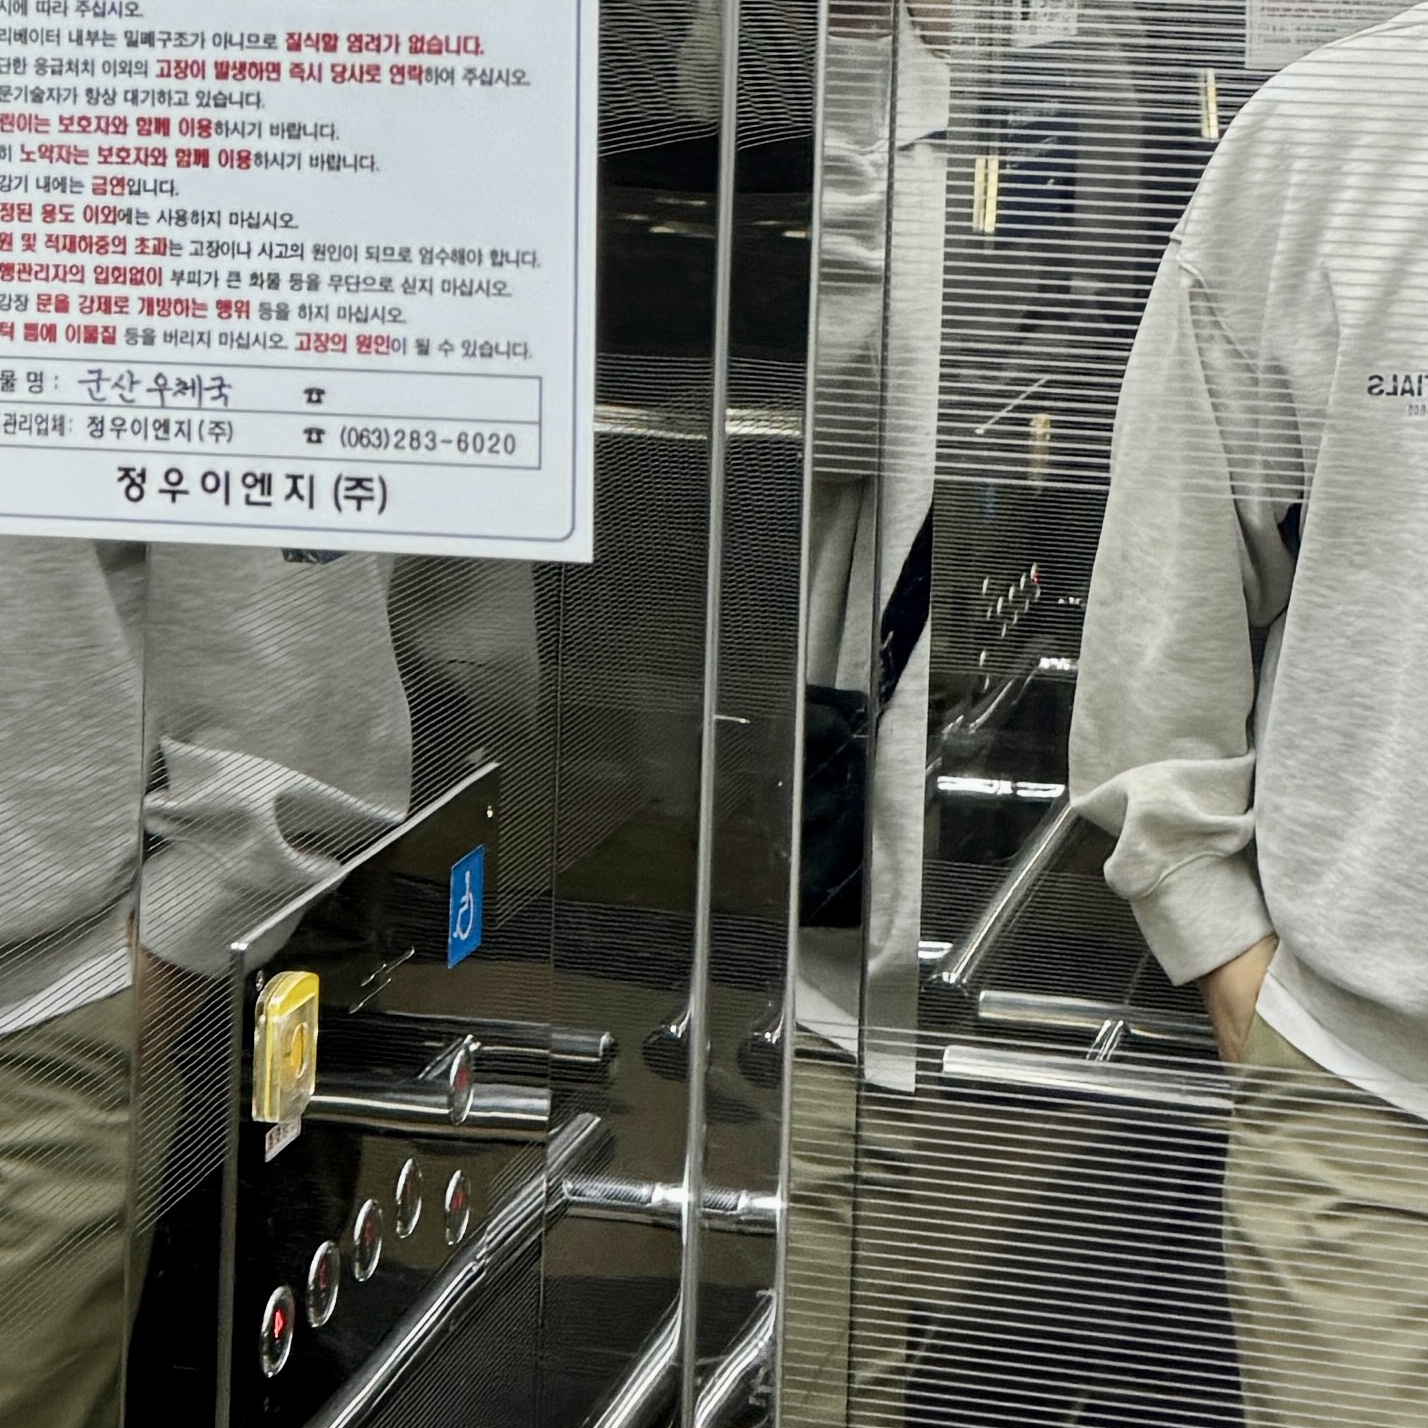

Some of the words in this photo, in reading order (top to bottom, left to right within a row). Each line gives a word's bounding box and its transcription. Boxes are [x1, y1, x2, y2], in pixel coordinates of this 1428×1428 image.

[36, 1, 68, 18] 따라
[68, 27, 117, 48] 내부는
[212, 31, 278, 52] 아니므로
[285, 31, 339, 54] 질식할
[346, 32, 401, 56] 염려가
[408, 33, 484, 57] 없습니다.
[33, 56, 95, 78] 응급처치
[102, 58, 148, 79] 이외의
[155, 58, 206, 81] 고장이
[214, 59, 281, 83] 발생하면
[289, 61, 323, 84] 즉시
[330, 62, 381, 84] 당사로
[389, 63, 455, 87] 연락하여
[85, 86, 117, 107] 항상
[123, 87, 190, 108] 대기하고
[195, 89, 265, 110] 있습니다.
[58, 114, 129, 137] 보호자와
[136, 116, 171, 138] 함께
[178, 116, 262, 140] 이용하시기
[269, 121, 339, 142] 바랍니다.
[20, 142, 89, 166] 노약자는
[97, 144, 168, 168] 보호자와
[175, 147, 210, 169] 함께
[218, 148, 302, 172] 이용하시기
[309, 152, 379, 174] 바랍니다.
[0, 173, 28, 194] 강기
[36, 174, 85, 195] 내에는
[91, 175, 179, 198] 금연입니다.
[41, 202, 75, 224] 용도
[83, 204, 150, 227] 이외에는
[156, 207, 221, 229] 사용하지
[21, 232, 37, 253] 및
[135, 236, 183, 258] 초과는
[189, 239, 252, 260] 고장이나
[257, 241, 304, 262] 사고의
[311, 242, 358, 264] 원인이
[365, 245, 413, 264] 되므로
[418, 246, 483, 268] 엄수해야
[490, 248, 542, 270] 합니다.
[170, 268, 219, 290] 부피가
[226, 270, 242, 290] 큰
[249, 271, 281, 291] 화물
[289, 272, 321, 293] 등을
[328, 273, 394, 294] 무단으로
[0, 293, 29, 312] 강장
[36, 292, 70, 314] 문을
[78, 294, 130, 316] 강제로
[138, 296, 208, 319] 개방하는
[215, 298, 250, 321] 행위
[258, 301, 291, 322] 등을
[298, 302, 329, 323] 하지
[65, 323, 117, 346] 이물질
[124, 326, 156, 347] 등을
[163, 328, 211, 349] 버리지
[295, 331, 347, 355] 고장의
[356, 333, 407, 356] 원인이
[438, 338, 455, 357] 수
[461, 339, 534, 361] 있습니다.
[0, 412, 73, 437] 관리업체:
[339, 424, 517, 456] (063)283-6020
